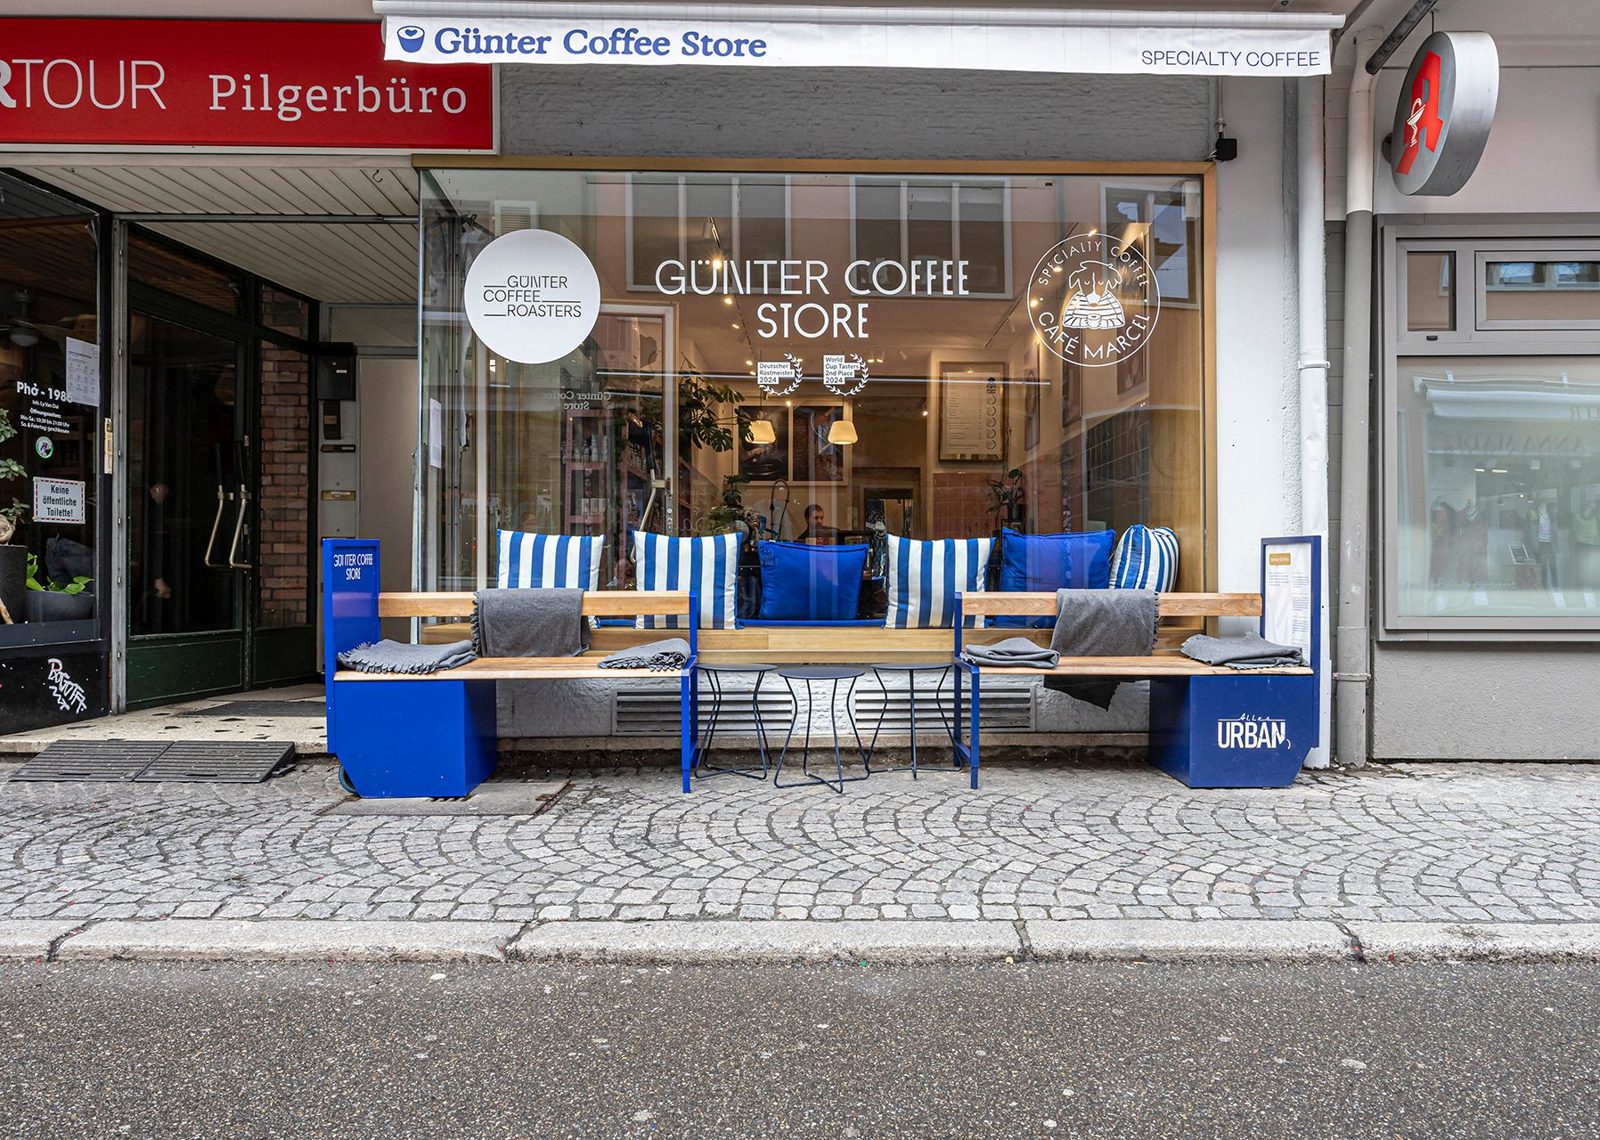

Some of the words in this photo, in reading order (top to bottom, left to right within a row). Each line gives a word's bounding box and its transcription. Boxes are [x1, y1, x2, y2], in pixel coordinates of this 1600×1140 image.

[434, 27, 552, 55] Günter
[563, 28, 670, 56] Coffee
[681, 31, 767, 57] Store
[1141, 50, 1242, 66] SPECIALTY
[1246, 51, 1321, 67] COFFEE
[209, 73, 468, 122] Pilgerbüro
[1038, 241, 1102, 286] SPECIALTY
[1110, 245, 1150, 287] COFFEE
[507, 274, 568, 289] GÜNTER
[654, 259, 830, 295] GÜNTER
[844, 260, 970, 296] COFFEE
[483, 289, 541, 303] COFFEE
[507, 303, 582, 318] ROASTERS
[756, 302, 869, 339] STORE
[1038, 311, 1080, 356] CAFÉ
[1084, 313, 1150, 360] MARCEL
[825, 363, 837, 371] Cup
[759, 376, 778, 384] 2024
[825, 376, 844, 384] 2024
[51, 485, 70, 495] Keine
[42, 496, 77, 507] öffentliche
[46, 507, 73, 517] Toilette!
